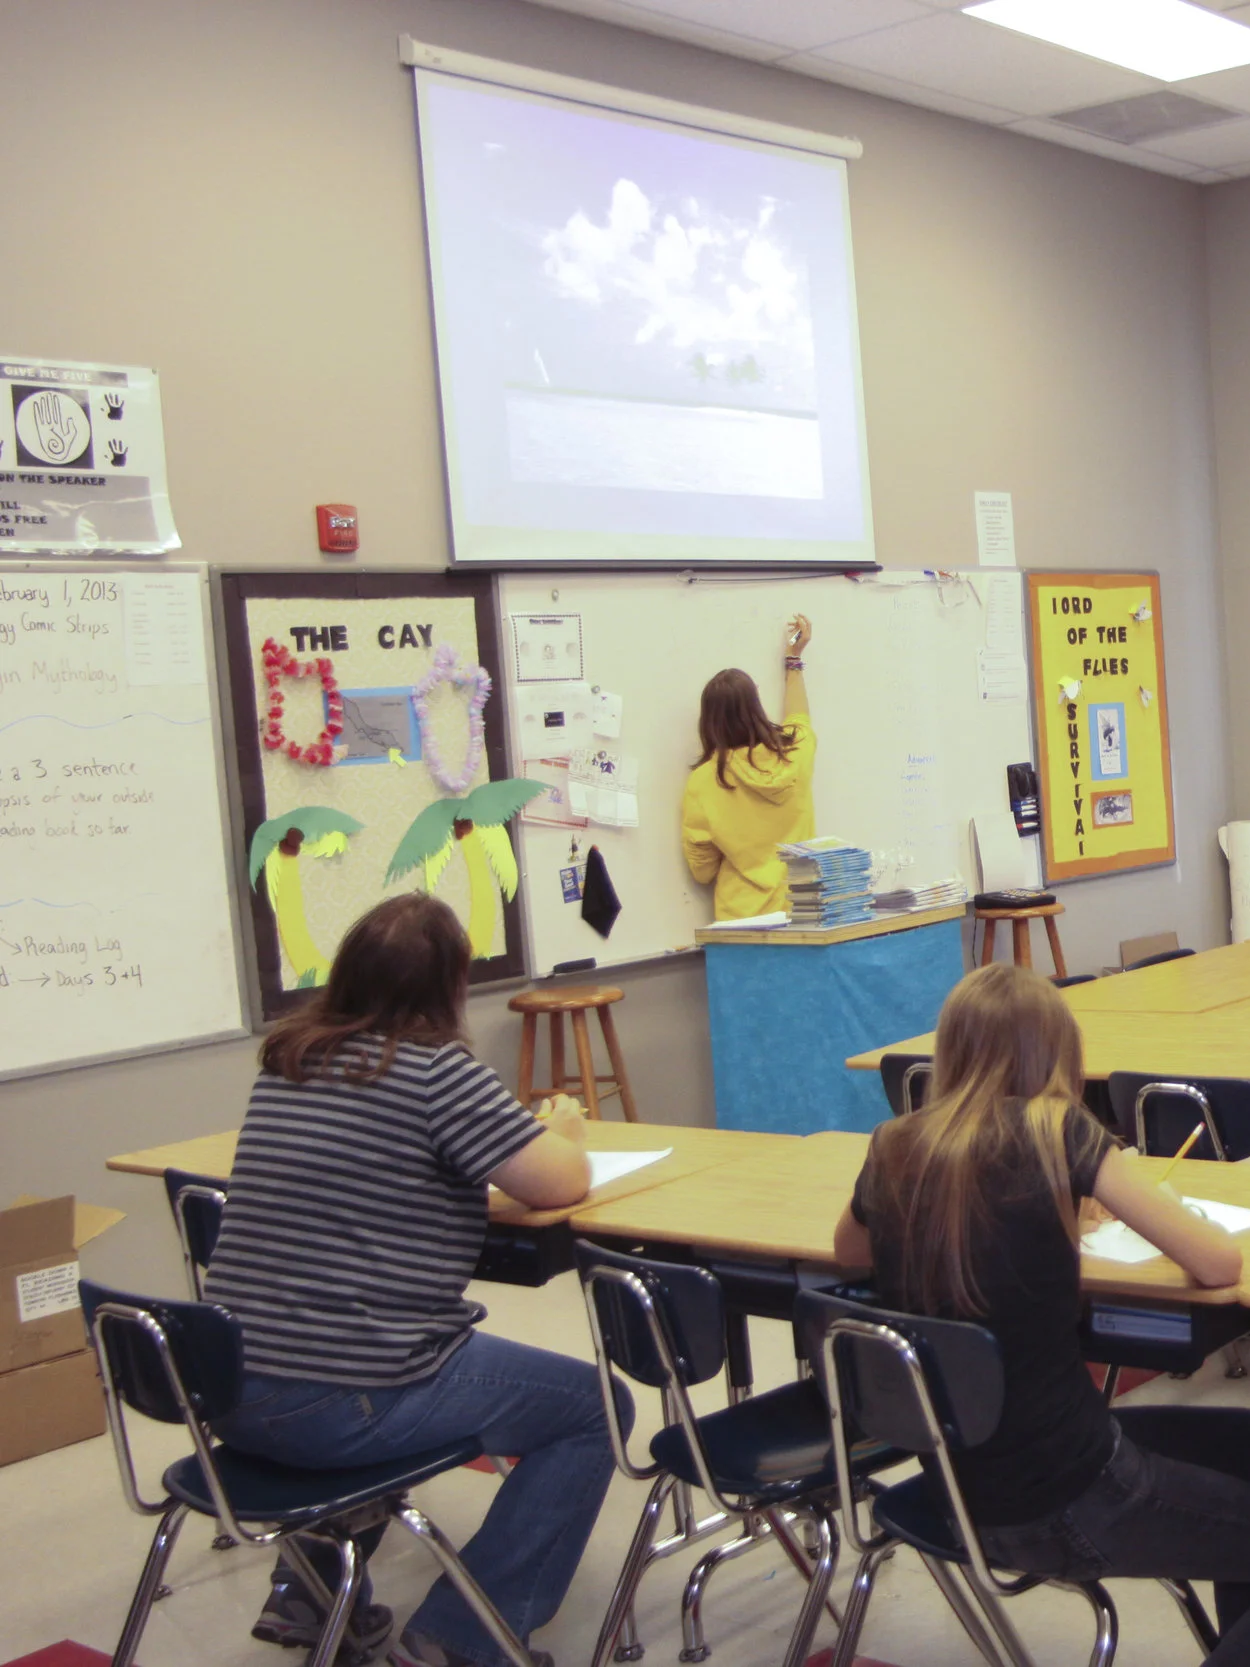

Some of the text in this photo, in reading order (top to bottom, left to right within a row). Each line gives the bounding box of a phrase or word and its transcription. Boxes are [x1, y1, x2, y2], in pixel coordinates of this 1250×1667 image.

[3, 367, 93, 382] GIVE ME FIVE
[19, 474, 45, 484] THE
[48, 475, 107, 487] SPEAKER
[15, 515, 48, 525] FREE
[0, 578, 50, 608] bruary
[80, 578, 118, 602] 2013
[21, 611, 57, 632] Comic
[66, 613, 110, 640] Strips
[1067, 626, 1128, 646] OF THE
[290, 623, 434, 652] THE CAY
[32, 658, 118, 696] Mythology
[1083, 657, 1129, 677] FLIES
[30, 758, 48, 779] 3
[62, 756, 139, 778] sentence
[45, 817, 79, 838] book
[23, 934, 124, 965] Reading Log
[55, 968, 94, 997] Days
